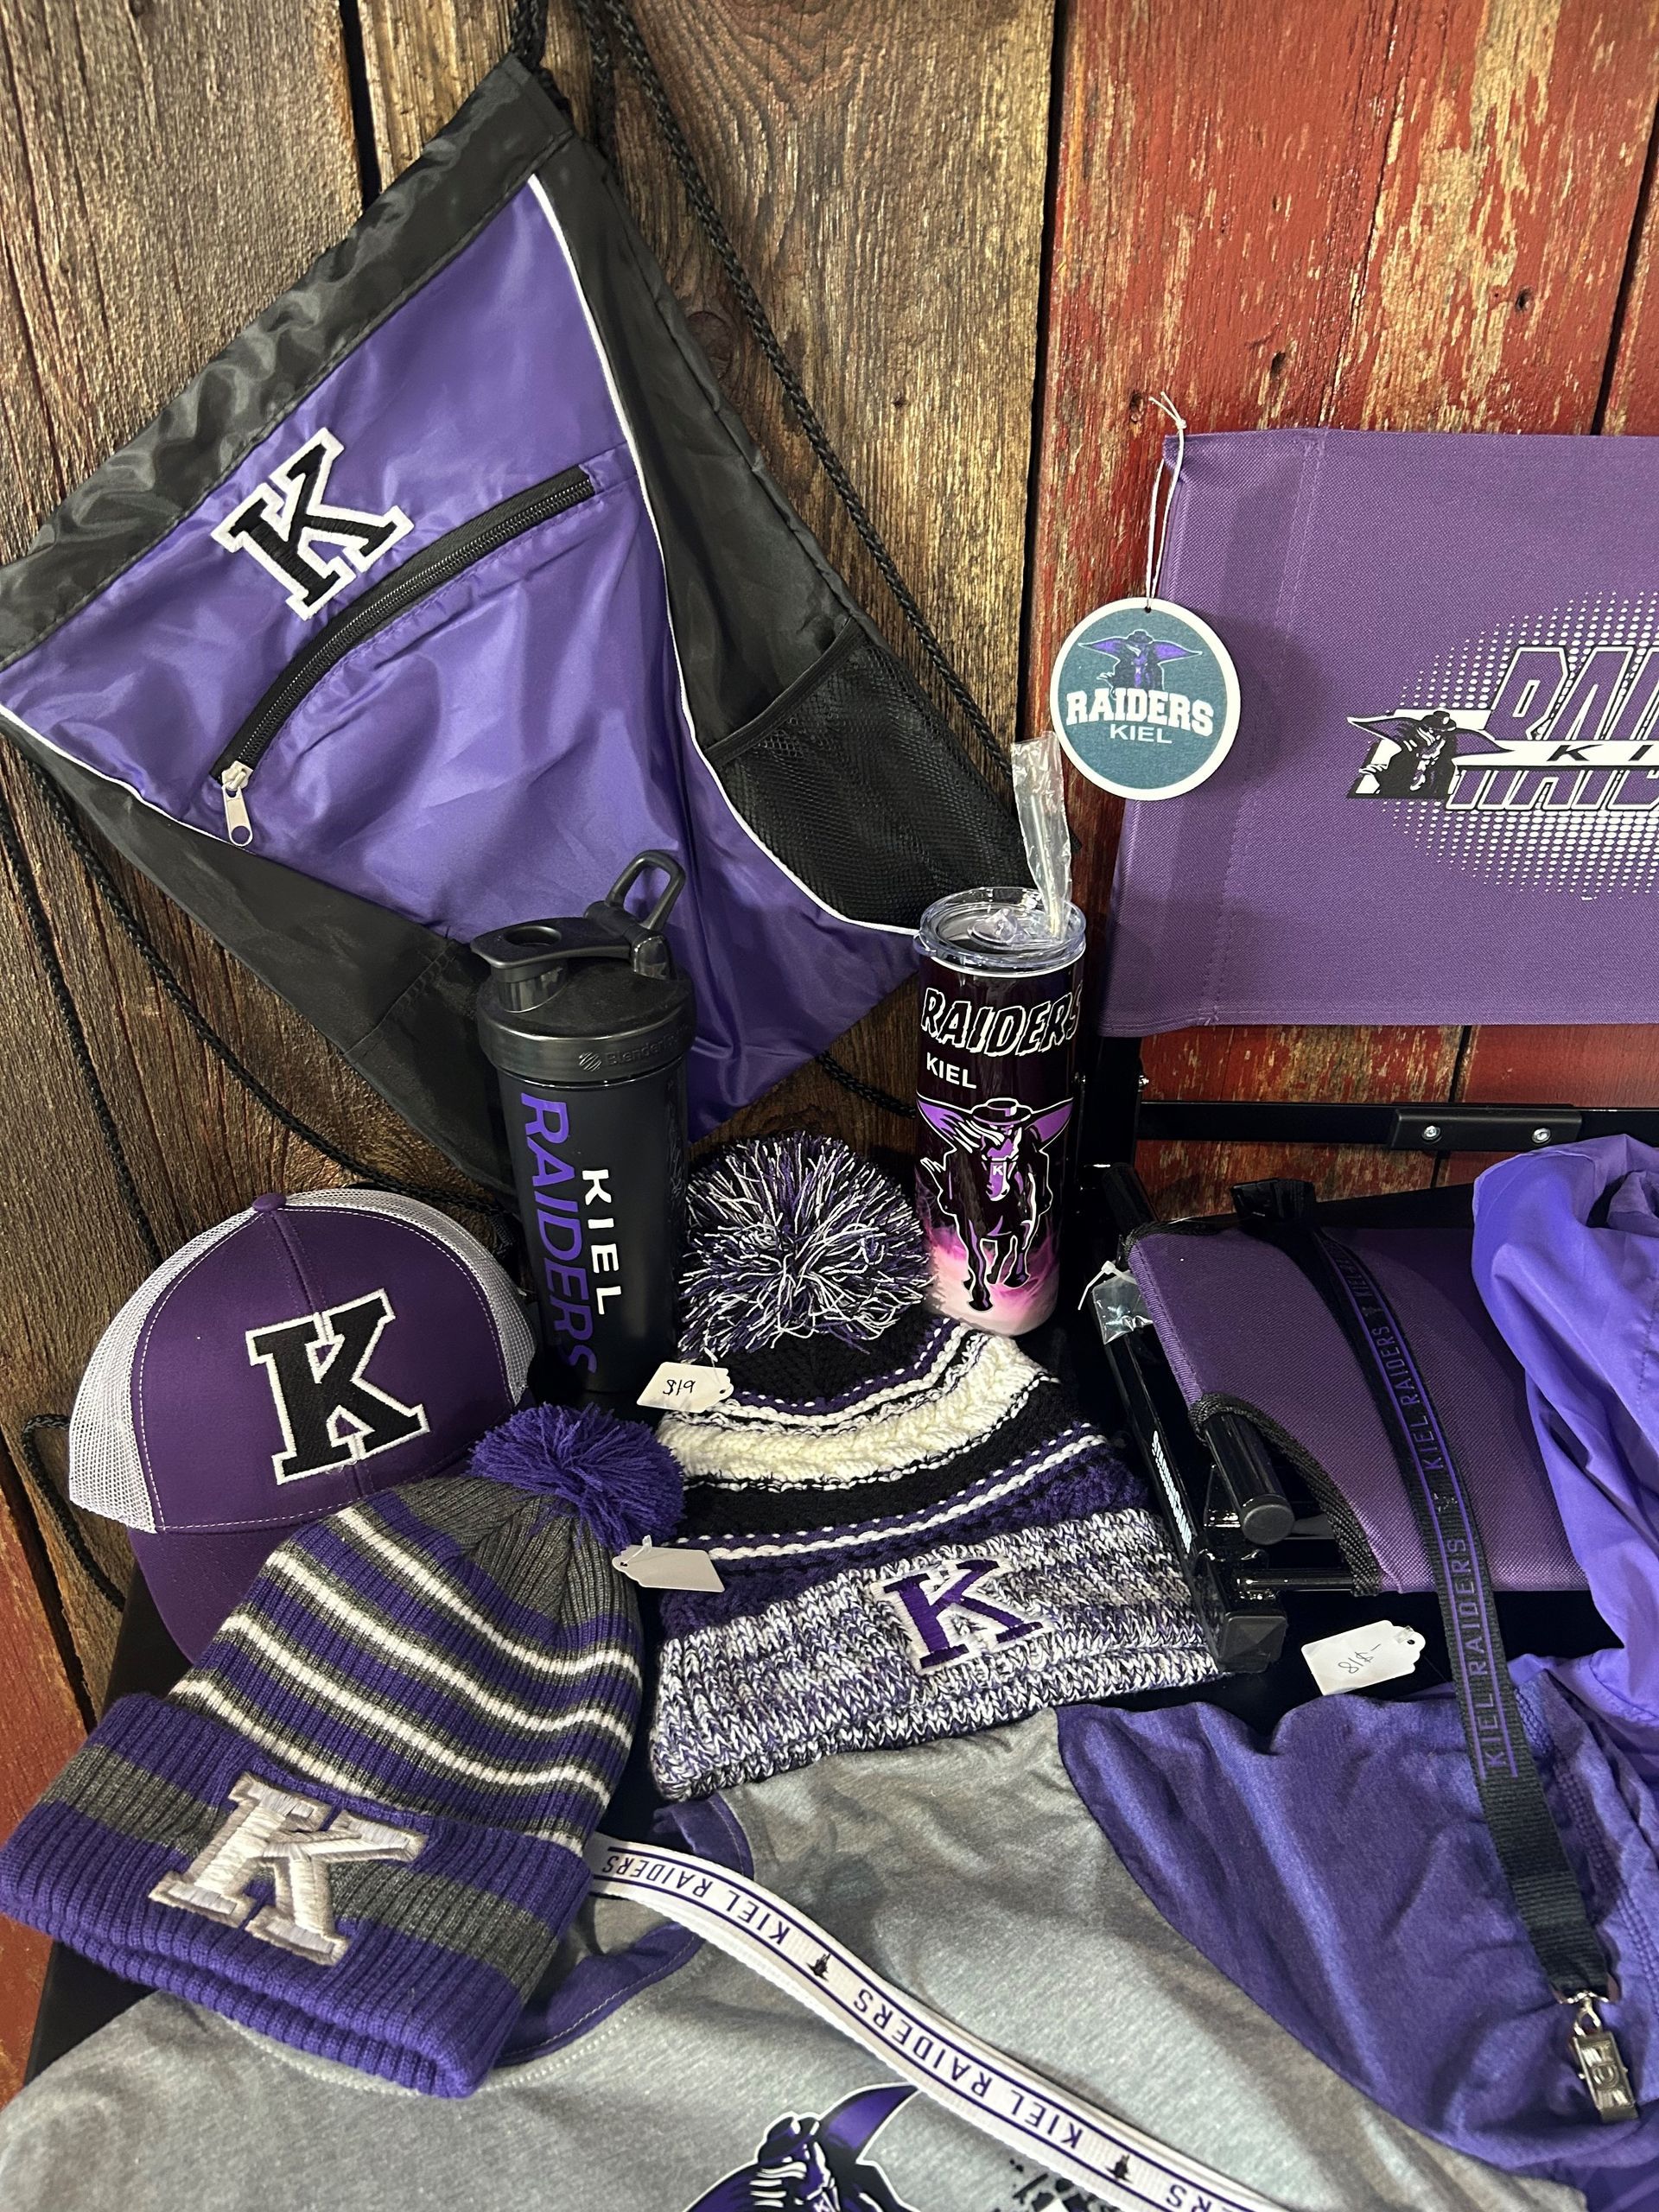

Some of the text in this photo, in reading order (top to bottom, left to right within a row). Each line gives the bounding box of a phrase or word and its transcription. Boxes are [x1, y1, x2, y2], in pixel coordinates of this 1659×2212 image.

[210, 426, 415, 621] K
[1065, 687, 1214, 736] RAIDERS
[1109, 723, 1173, 743] KIEL
[926, 1052, 976, 1089] KIEL
[521, 1092, 597, 1374] RAIDERS
[582, 1169, 621, 1315] KIEL
[245, 1288, 430, 1485] K
[1371, 1326, 1420, 1407] RAIDERS
[1413, 1415, 1444, 1469] KIEL
[871, 1557, 1055, 1675] K
[1446, 1537, 1507, 1768] KIEL RAIDERS
[148, 1771, 429, 1967] K
[602, 1855, 714, 1898] RAIDERS
[727, 1889, 791, 1946] KIEL
[853, 1988, 992, 2098] RAIDERS
[1010, 2089, 1083, 2150] KIEL
